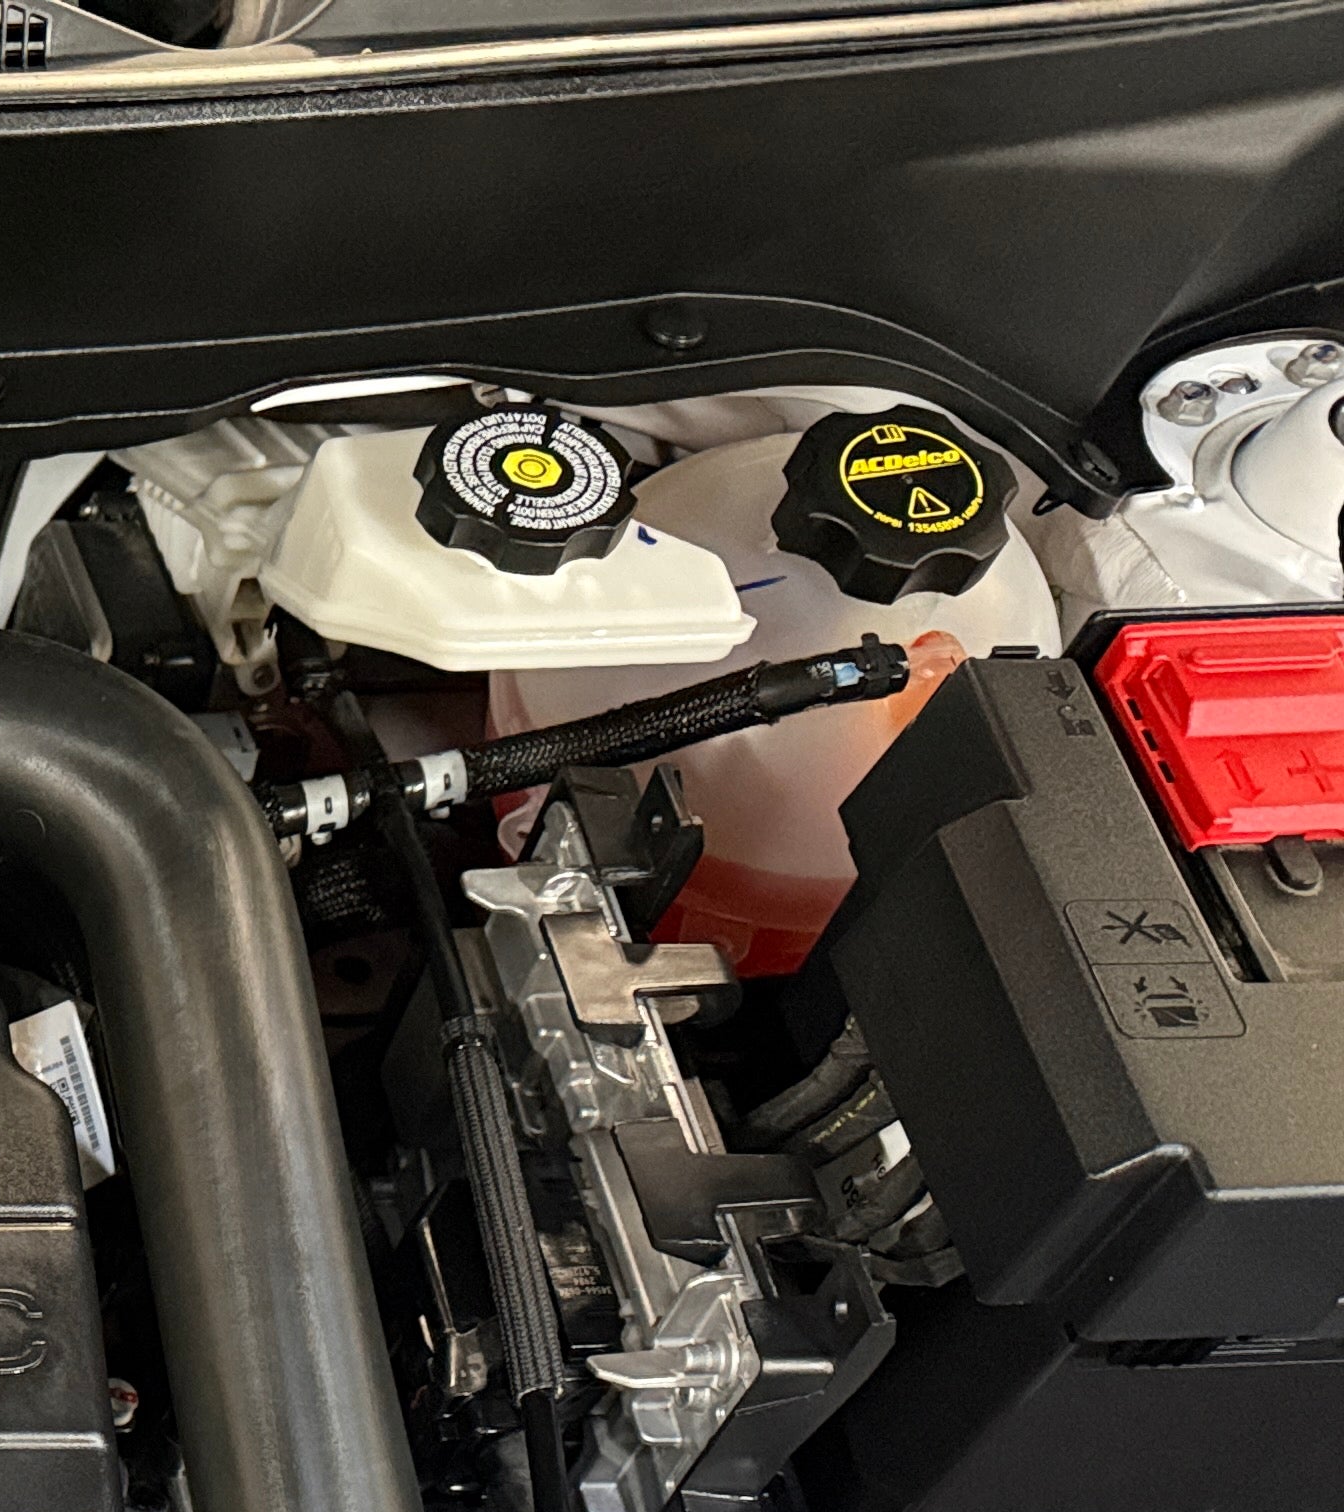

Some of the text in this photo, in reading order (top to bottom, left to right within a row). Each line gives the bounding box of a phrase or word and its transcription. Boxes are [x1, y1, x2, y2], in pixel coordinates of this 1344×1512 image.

[481, 413, 514, 426] FLUID
[849, 449, 961, 475] ACDelco
[479, 471, 509, 498] FILLER
[475, 486, 503, 505] ONLY
[552, 515, 584, 529] AVANT
